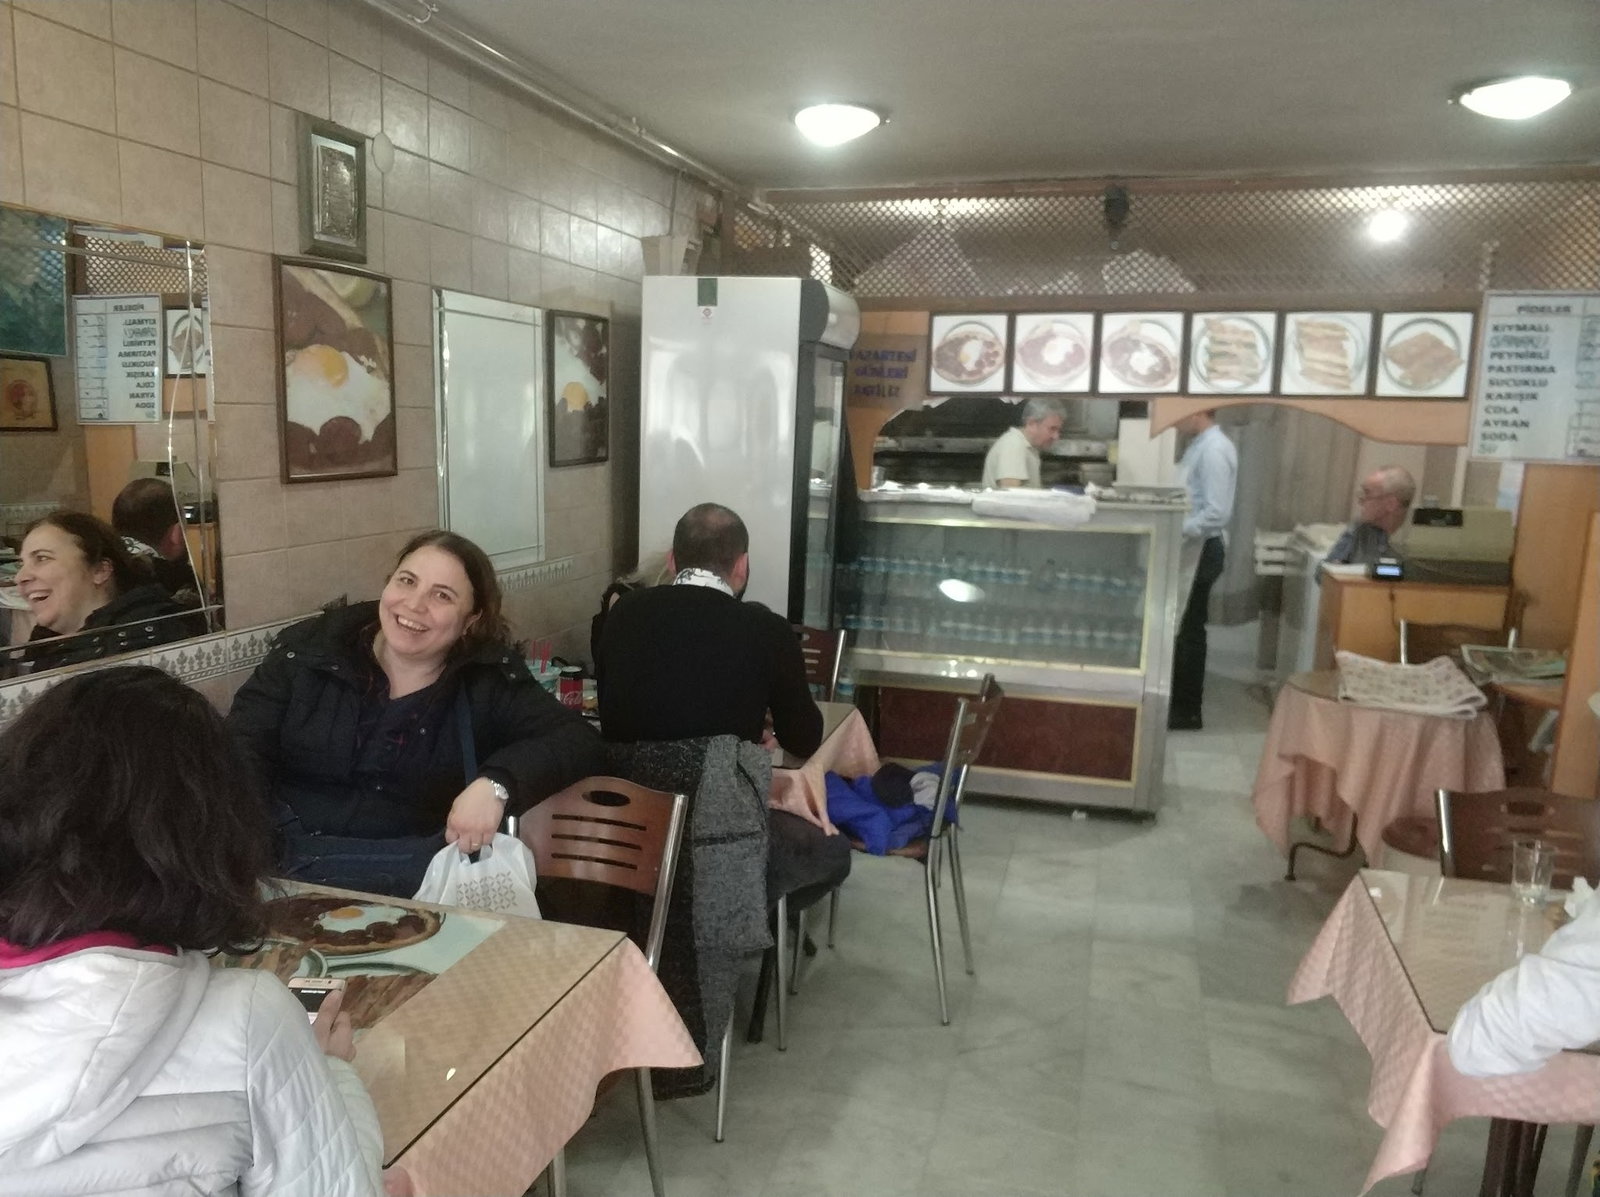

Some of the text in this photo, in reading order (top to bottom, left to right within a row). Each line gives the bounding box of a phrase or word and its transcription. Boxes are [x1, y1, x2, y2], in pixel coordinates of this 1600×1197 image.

[1484, 406, 1519, 415] COLA
[1482, 419, 1530, 428] AYRAN
[1480, 432, 1518, 442] SODA
